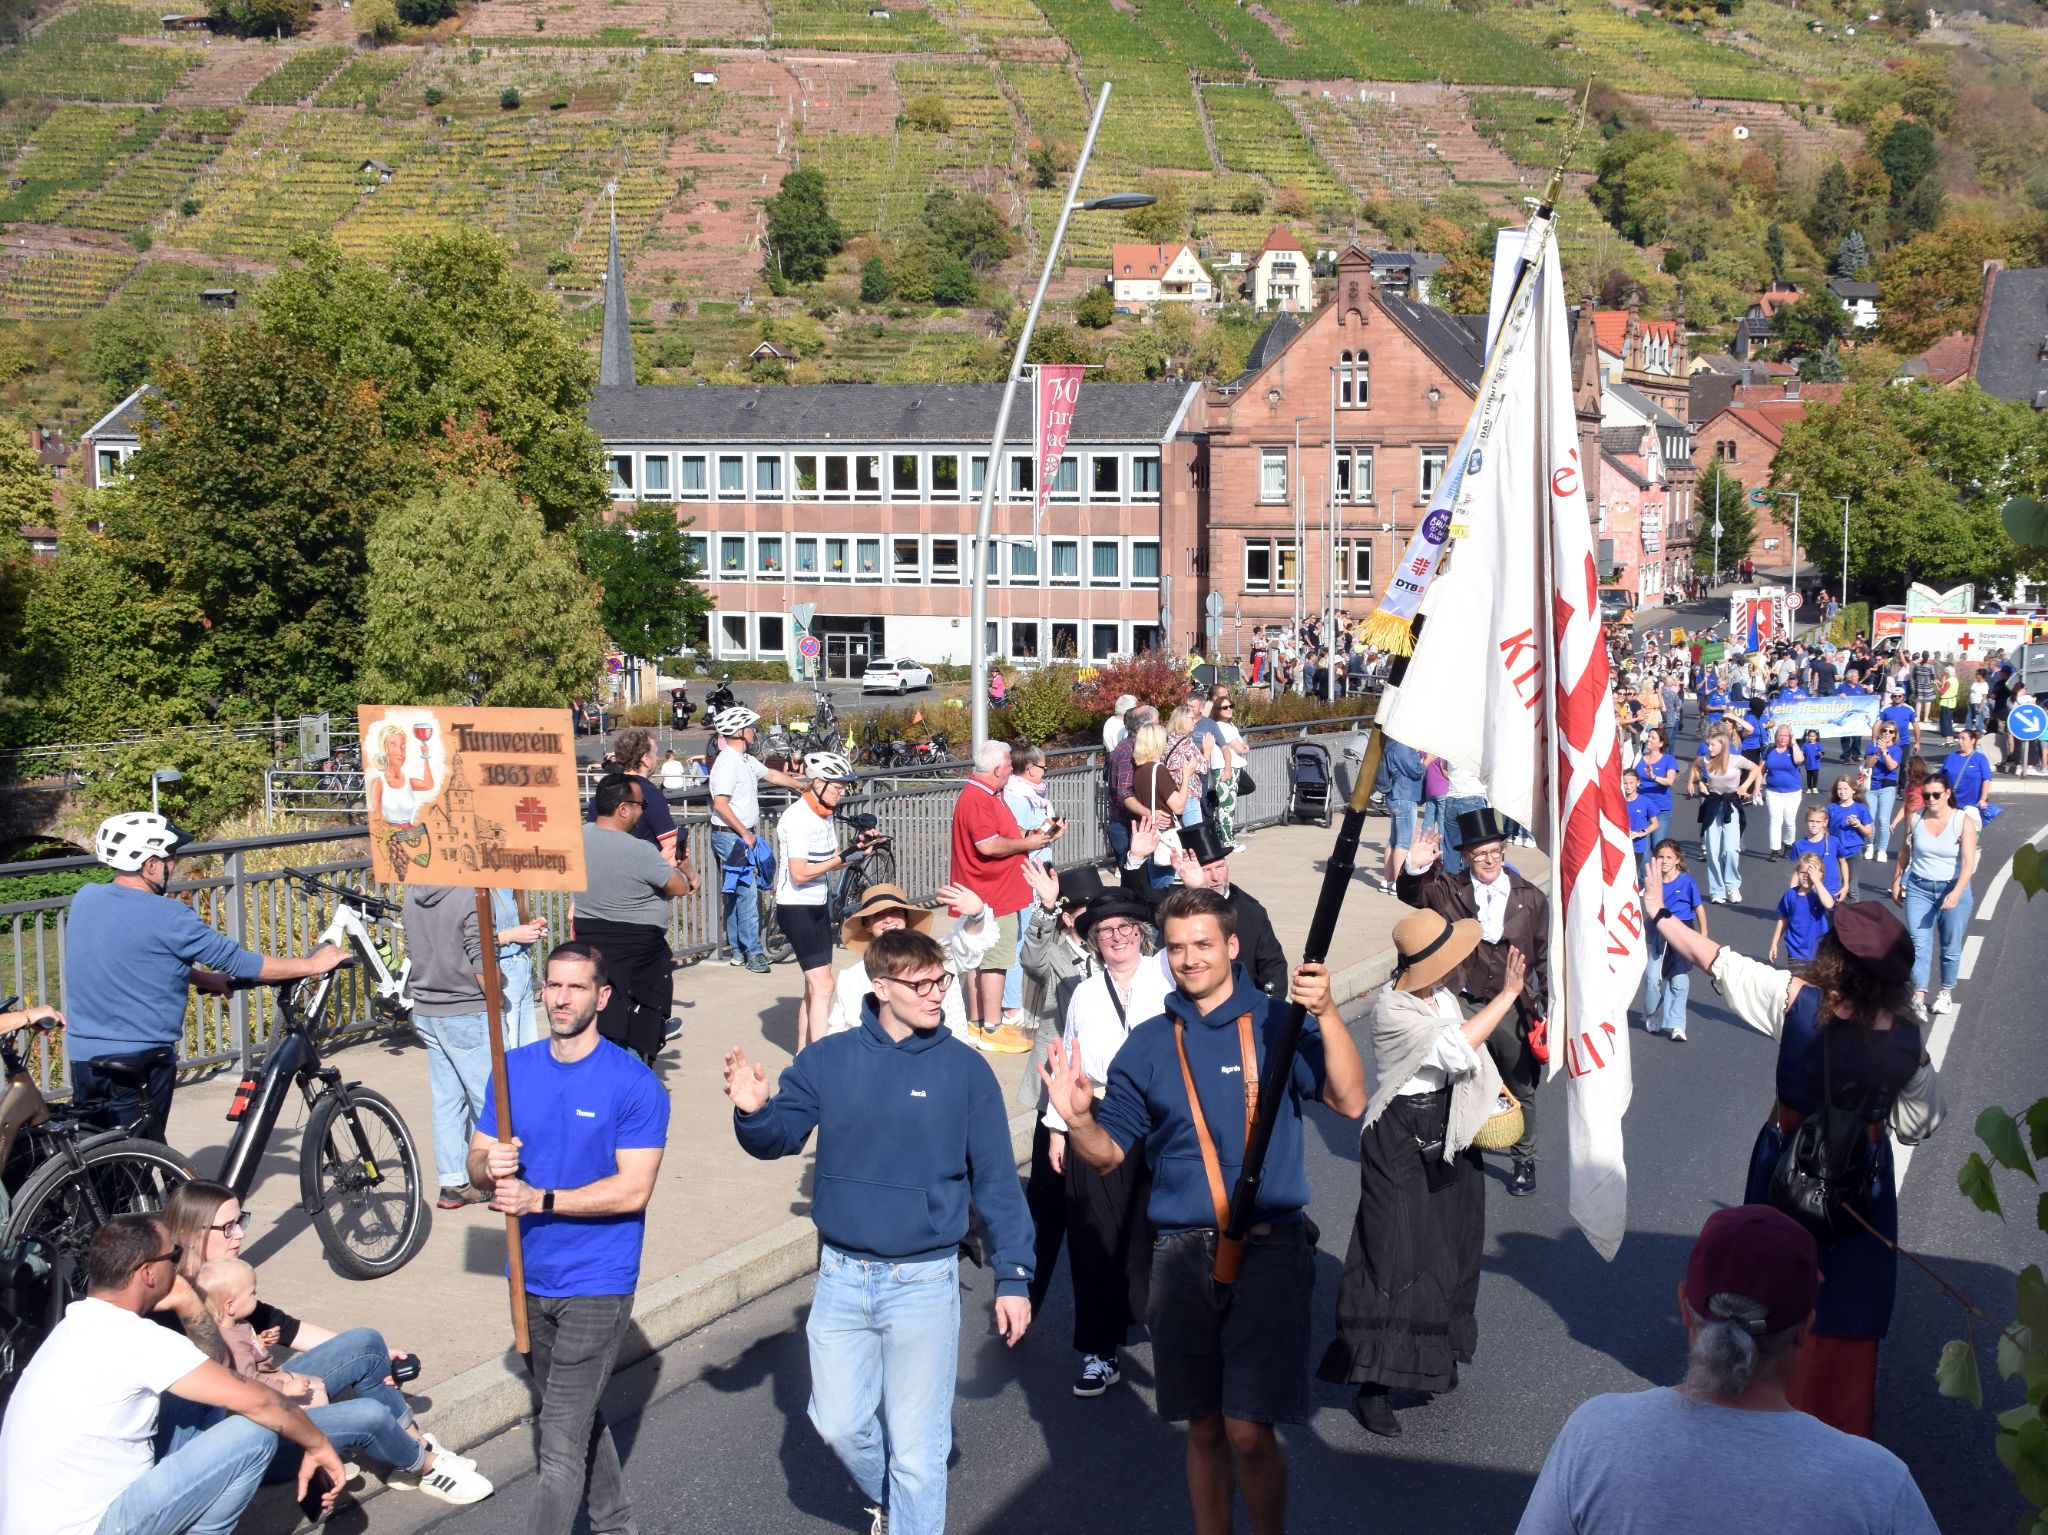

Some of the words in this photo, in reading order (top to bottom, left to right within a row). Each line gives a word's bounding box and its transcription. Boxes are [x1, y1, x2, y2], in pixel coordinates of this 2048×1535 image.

[1395, 578, 1419, 593] DTB
[1788, 597, 1799, 605] 30
[451, 722, 562, 753] Turnverein
[486, 765, 529, 786] 1863
[480, 843, 567, 875] Klingenberg
